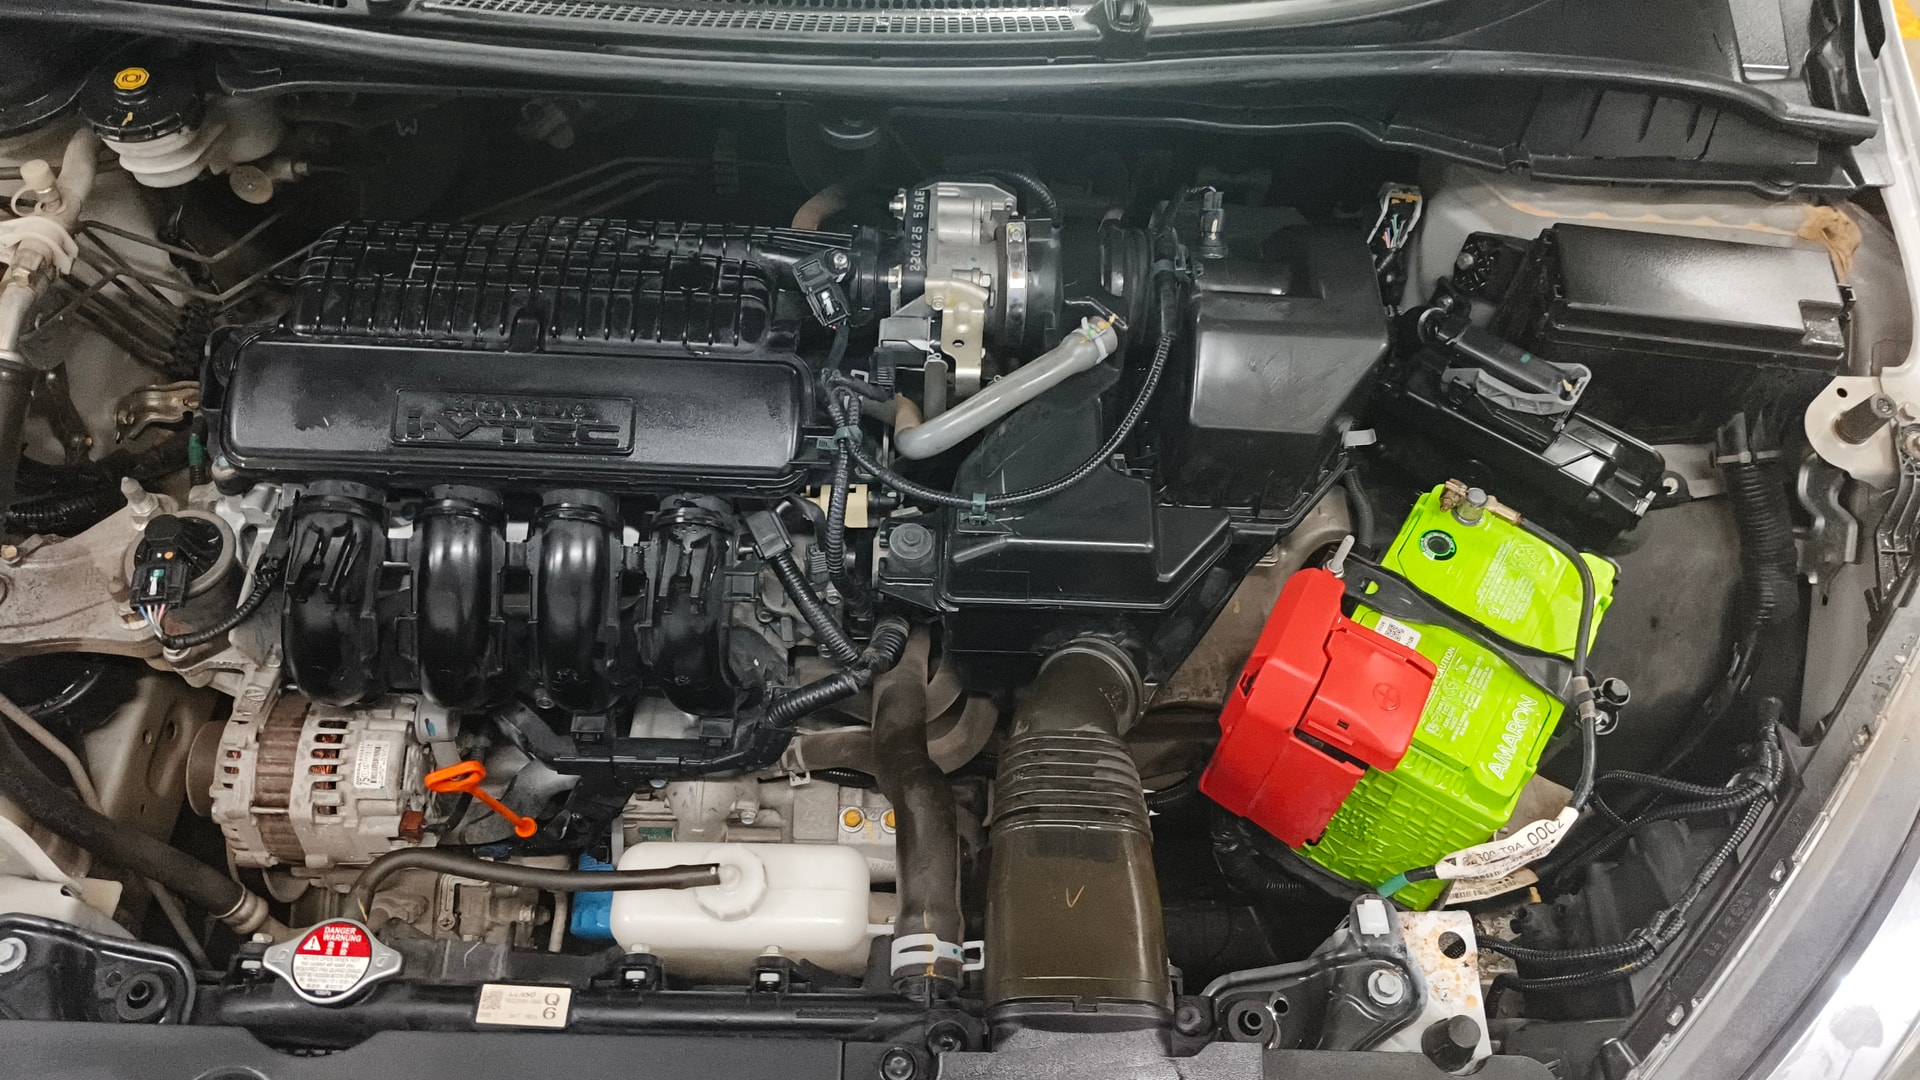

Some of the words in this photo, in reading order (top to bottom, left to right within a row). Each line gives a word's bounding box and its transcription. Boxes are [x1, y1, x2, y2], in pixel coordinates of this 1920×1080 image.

[1488, 694, 1539, 780] AMARON
[324, 926, 356, 935] DANGER
[323, 933, 362, 942] WARNUNG
[544, 993, 560, 1006] Q
[542, 1006, 557, 1019] 6
